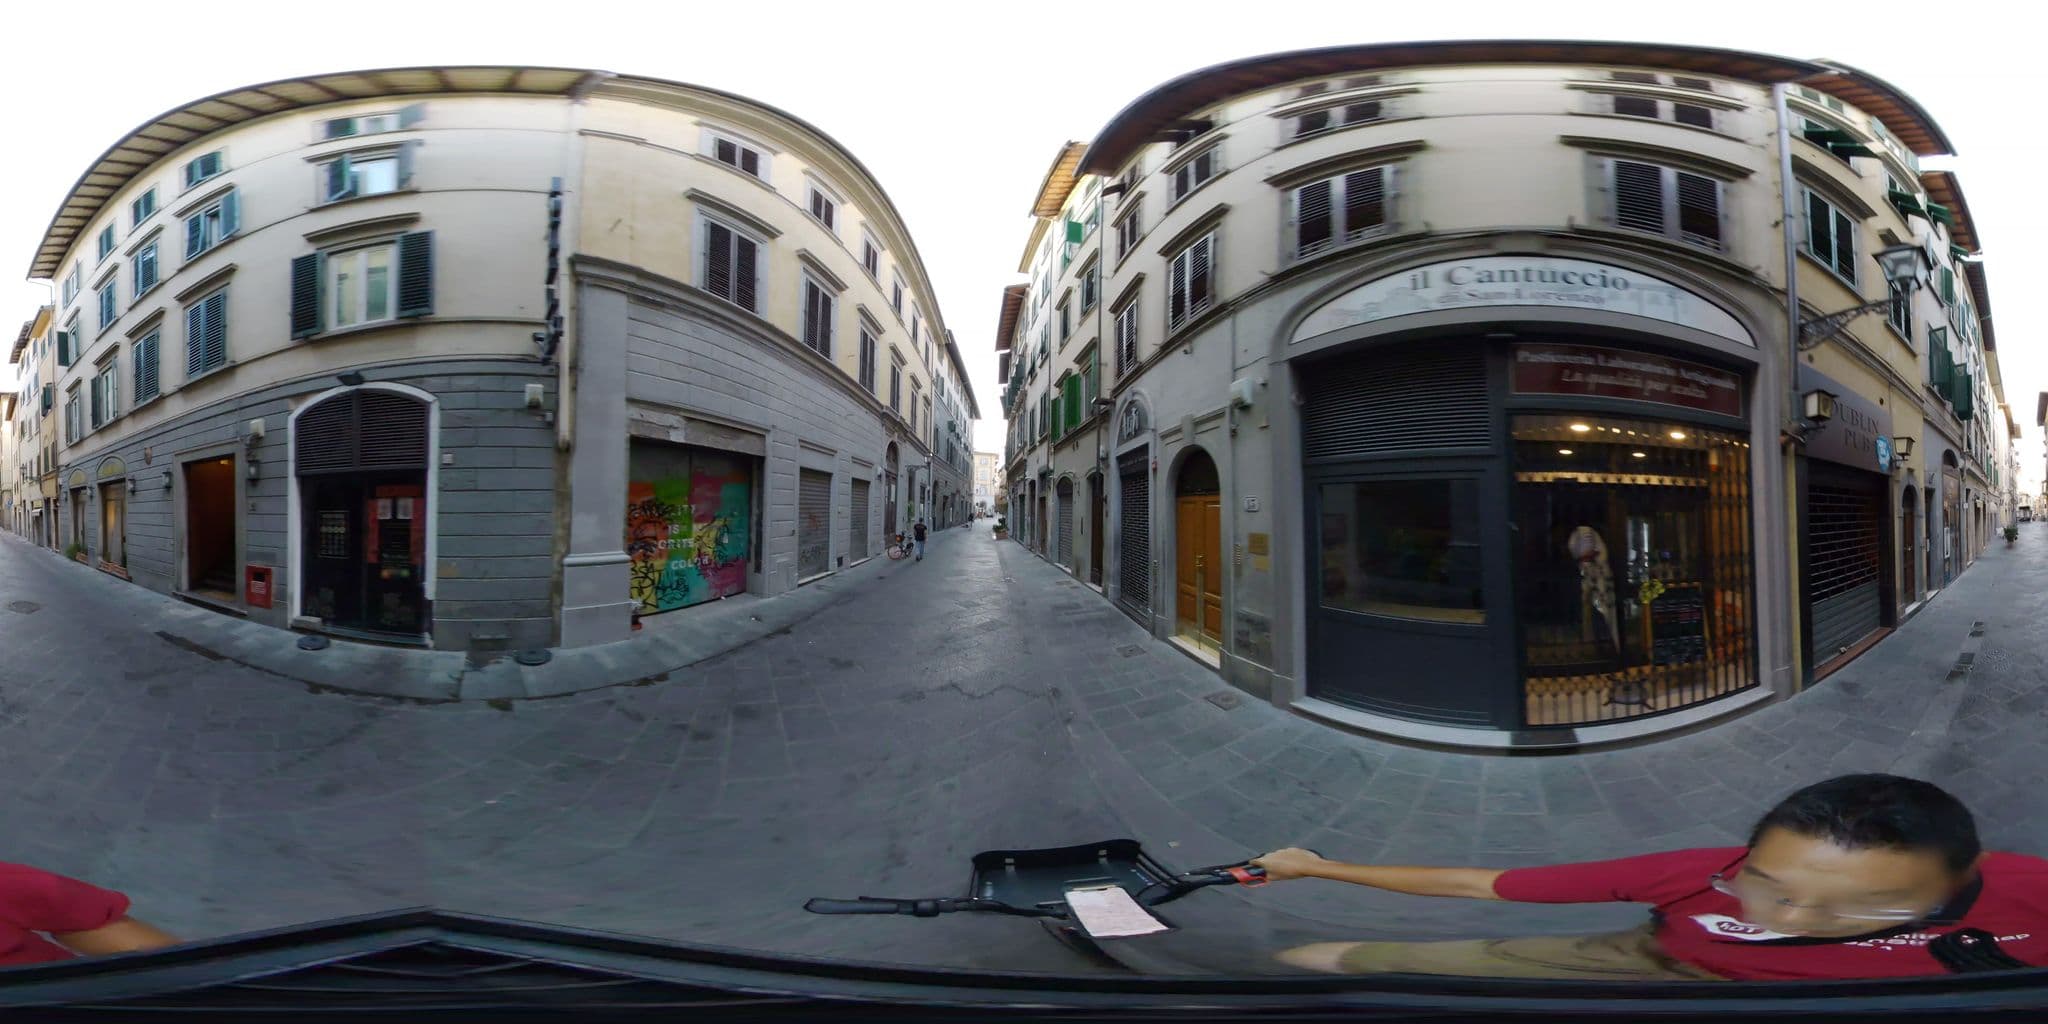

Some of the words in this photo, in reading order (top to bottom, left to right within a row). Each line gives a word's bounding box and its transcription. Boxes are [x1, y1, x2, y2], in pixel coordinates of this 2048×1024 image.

[1411, 270, 1431, 290] il
[1447, 265, 1630, 291] Cantuccio
[1844, 428, 1871, 452] PUB
